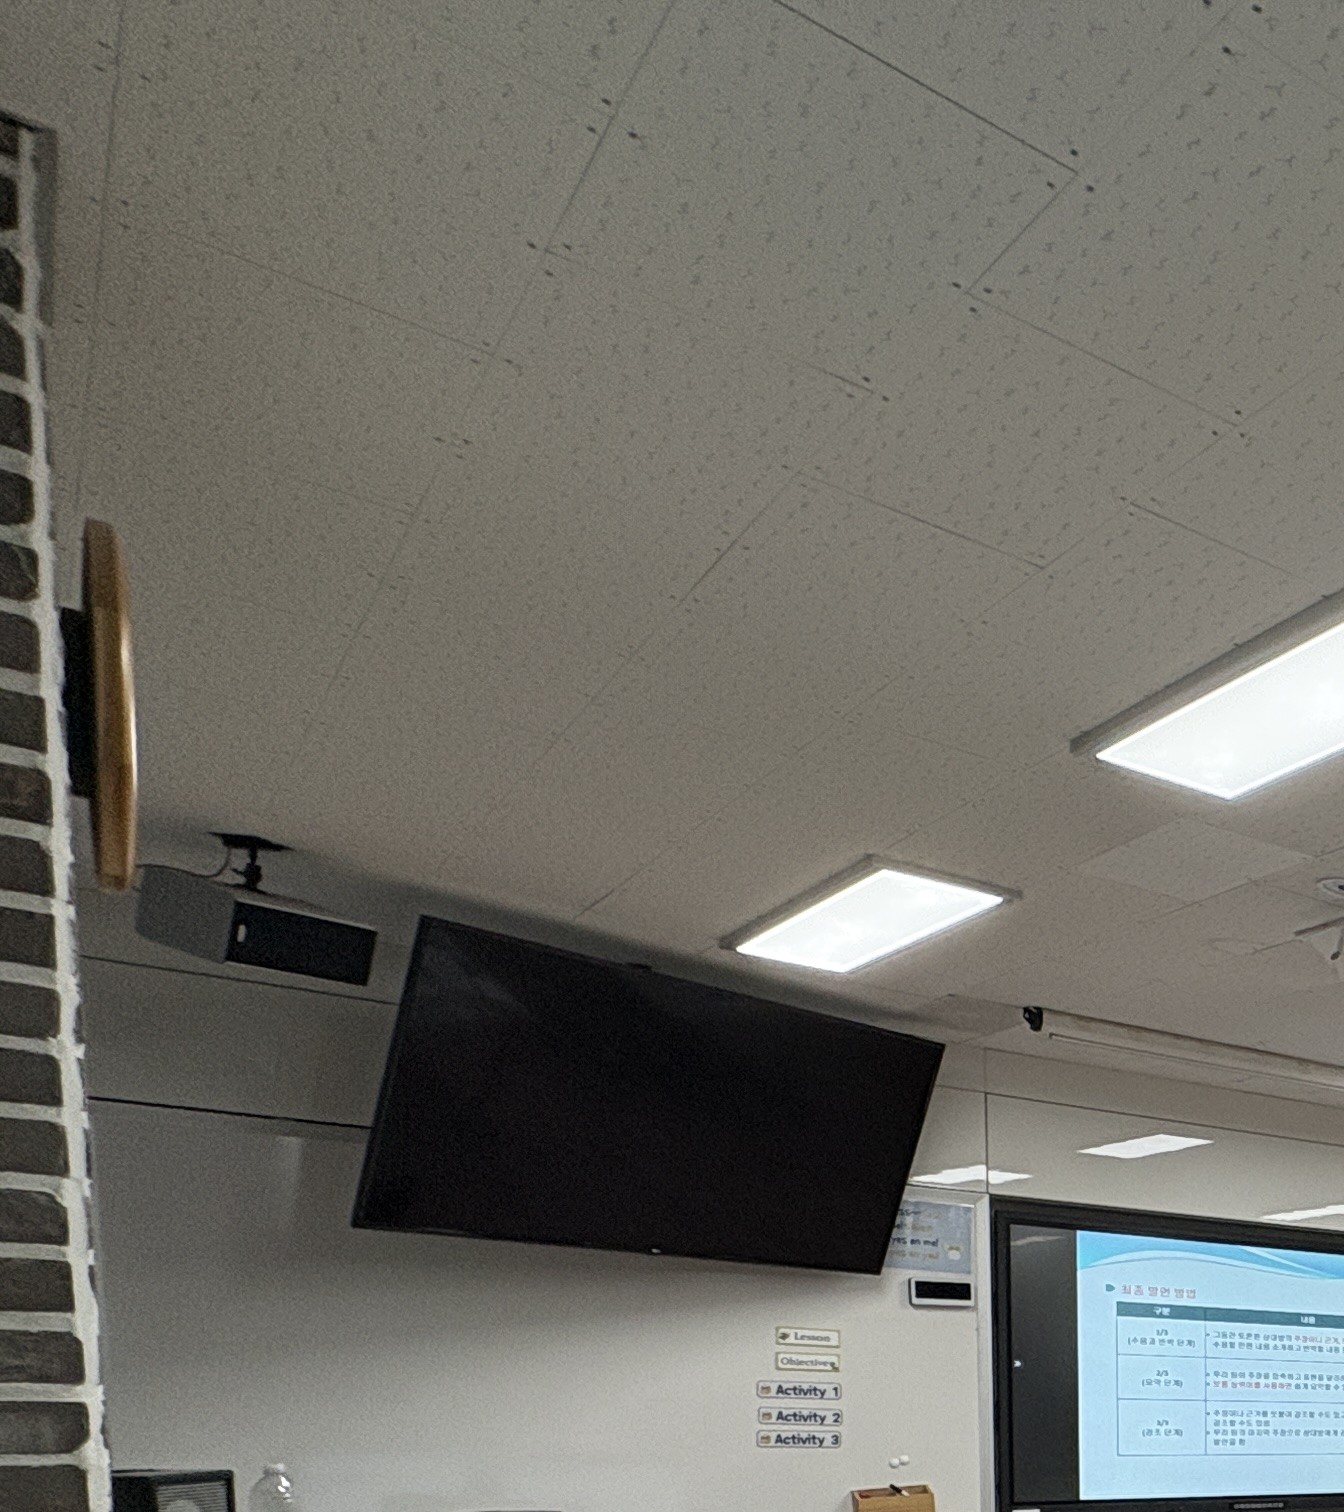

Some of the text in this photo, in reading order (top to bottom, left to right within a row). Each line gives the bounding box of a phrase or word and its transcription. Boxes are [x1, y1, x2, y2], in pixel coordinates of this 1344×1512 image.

[794, 1332, 831, 1343] Lesson
[776, 1384, 838, 1399] Activity 1
[776, 1411, 840, 1425] Activity 2
[775, 1434, 839, 1448] Activity 3
